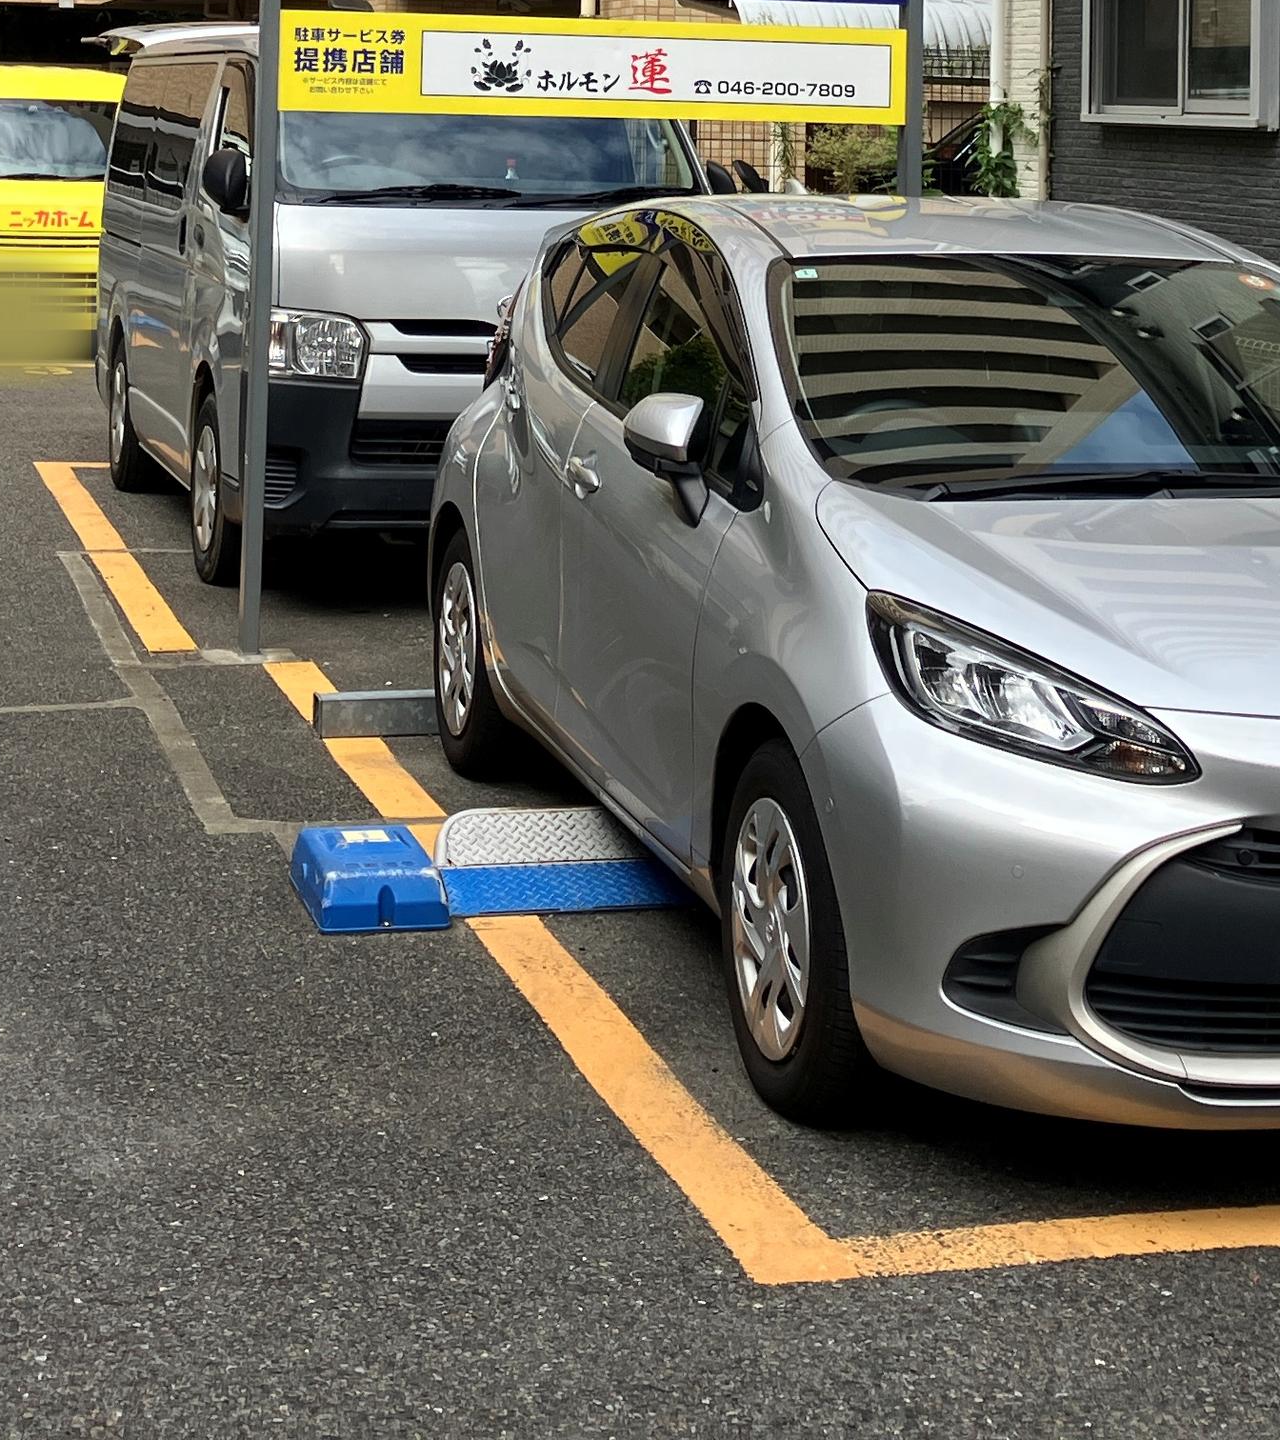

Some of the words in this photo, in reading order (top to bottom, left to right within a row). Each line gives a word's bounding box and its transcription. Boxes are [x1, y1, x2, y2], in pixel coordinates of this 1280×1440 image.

[294, 27, 406, 45] 駐車サービス券
[294, 47, 405, 74] 提携店舗
[536, 69, 621, 93] ホルモン
[628, 48, 673, 95] 蓮
[718, 81, 856, 98] 046-200-7809
[8, 210, 96, 229] ニッカホーム
